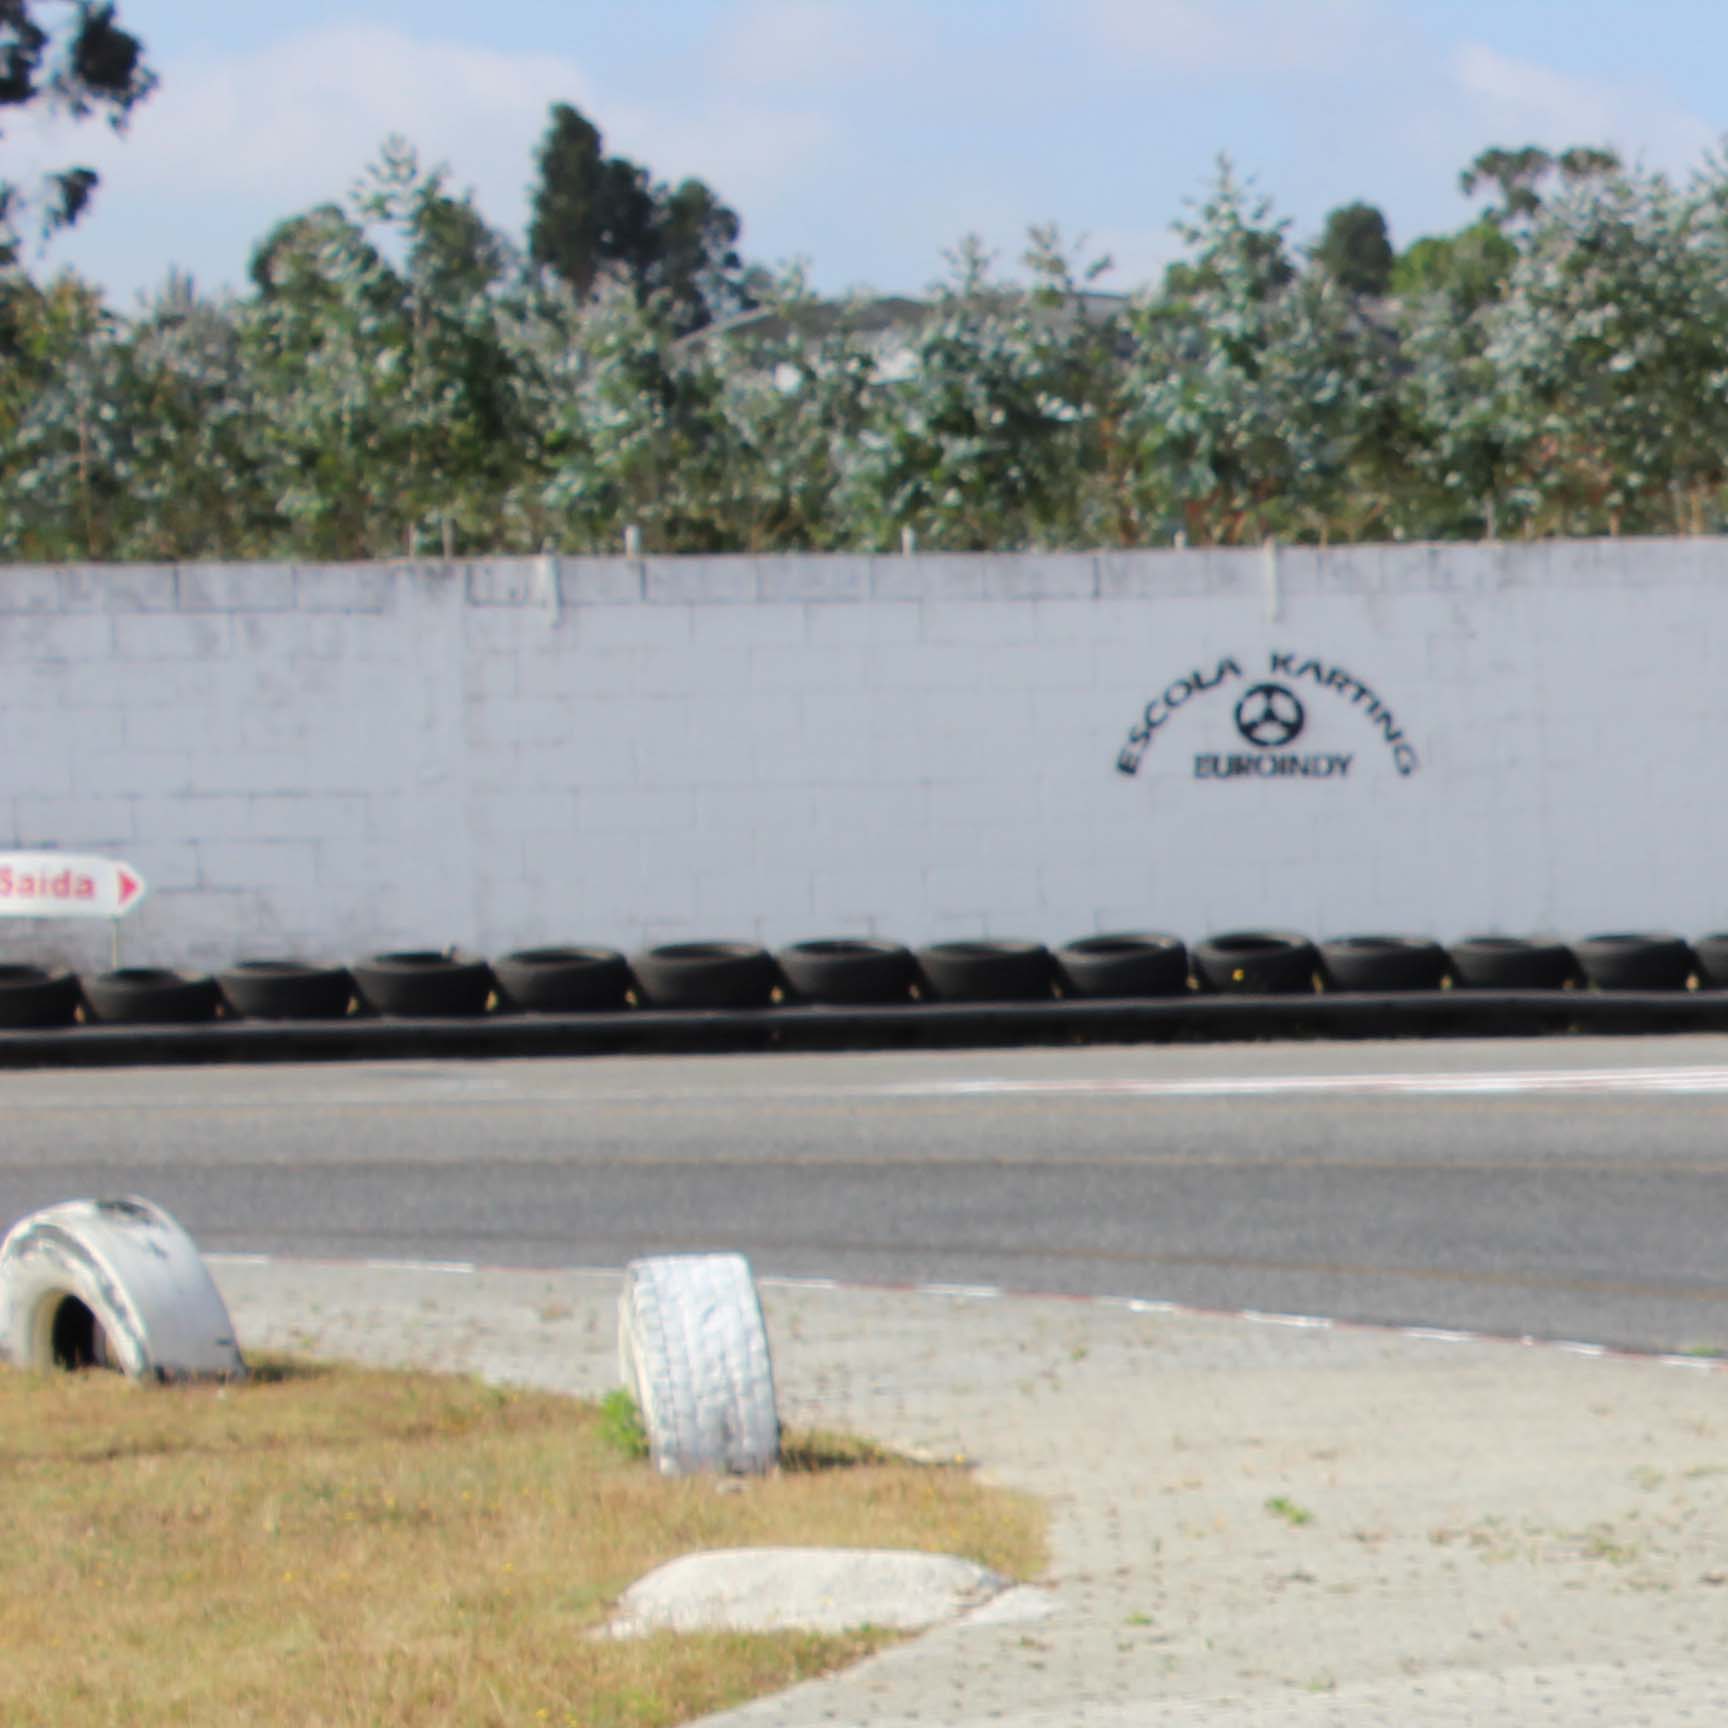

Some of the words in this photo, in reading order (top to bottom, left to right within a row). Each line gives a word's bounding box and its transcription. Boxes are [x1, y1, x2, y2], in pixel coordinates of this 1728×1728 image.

[1116, 655, 1242, 776] ESCOLA
[1270, 651, 1420, 777] KARTING
[1194, 752, 1354, 779] EUROINDY
